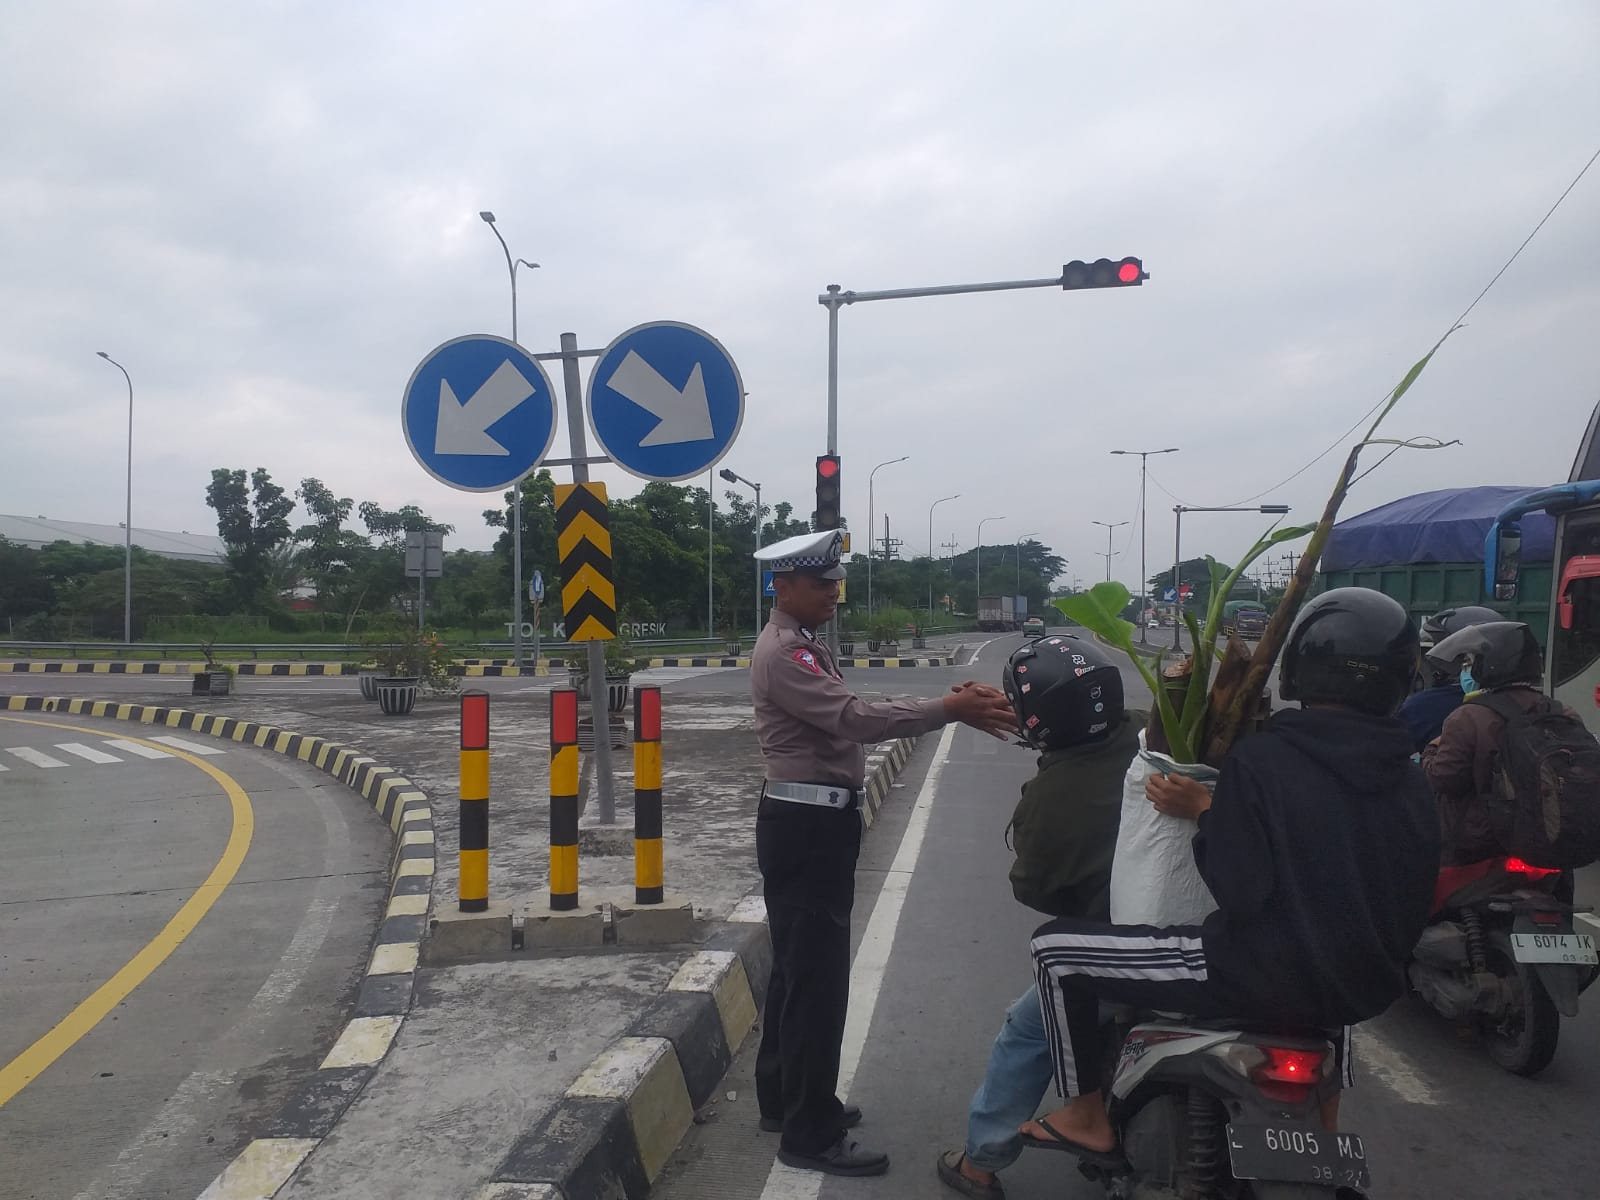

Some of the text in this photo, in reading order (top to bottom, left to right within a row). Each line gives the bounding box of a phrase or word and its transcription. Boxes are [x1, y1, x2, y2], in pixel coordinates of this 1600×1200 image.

[1514, 934, 1525, 948] L
[1533, 935, 1567, 949] 6074
[1265, 1128, 1320, 1155] 6005
